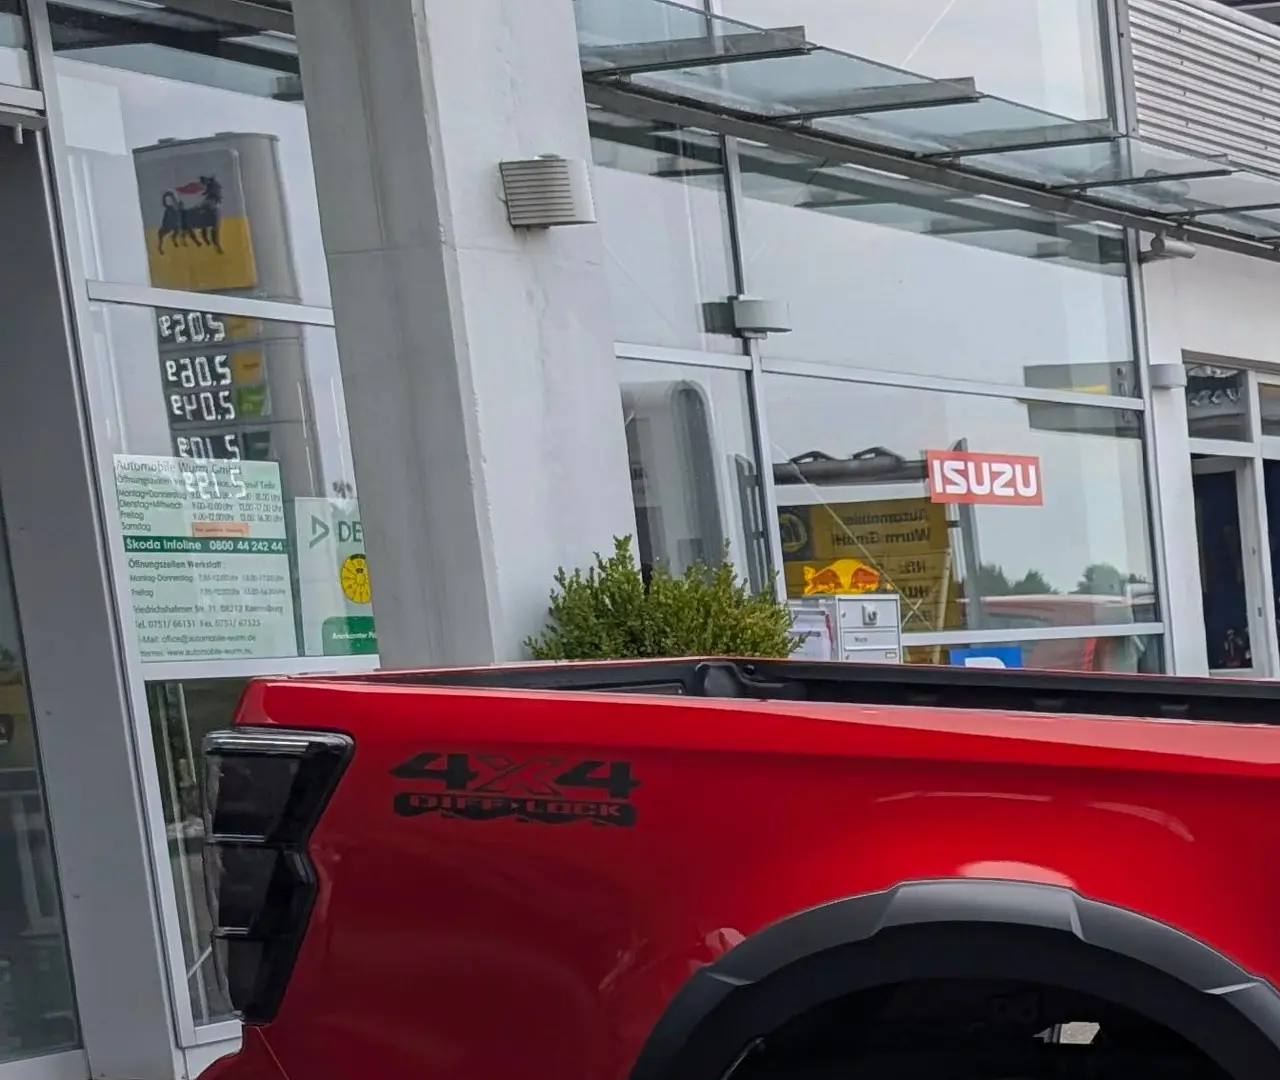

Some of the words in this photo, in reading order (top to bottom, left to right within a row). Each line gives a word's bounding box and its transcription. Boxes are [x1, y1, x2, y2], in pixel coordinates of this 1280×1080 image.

[932, 459, 1037, 497] ISUZU
[126, 538, 161, 550] Škoda
[164, 539, 201, 550] Infoline
[209, 540, 234, 551] 0800
[237, 540, 250, 551] 44
[251, 540, 271, 551] 242
[271, 541, 283, 551] 44
